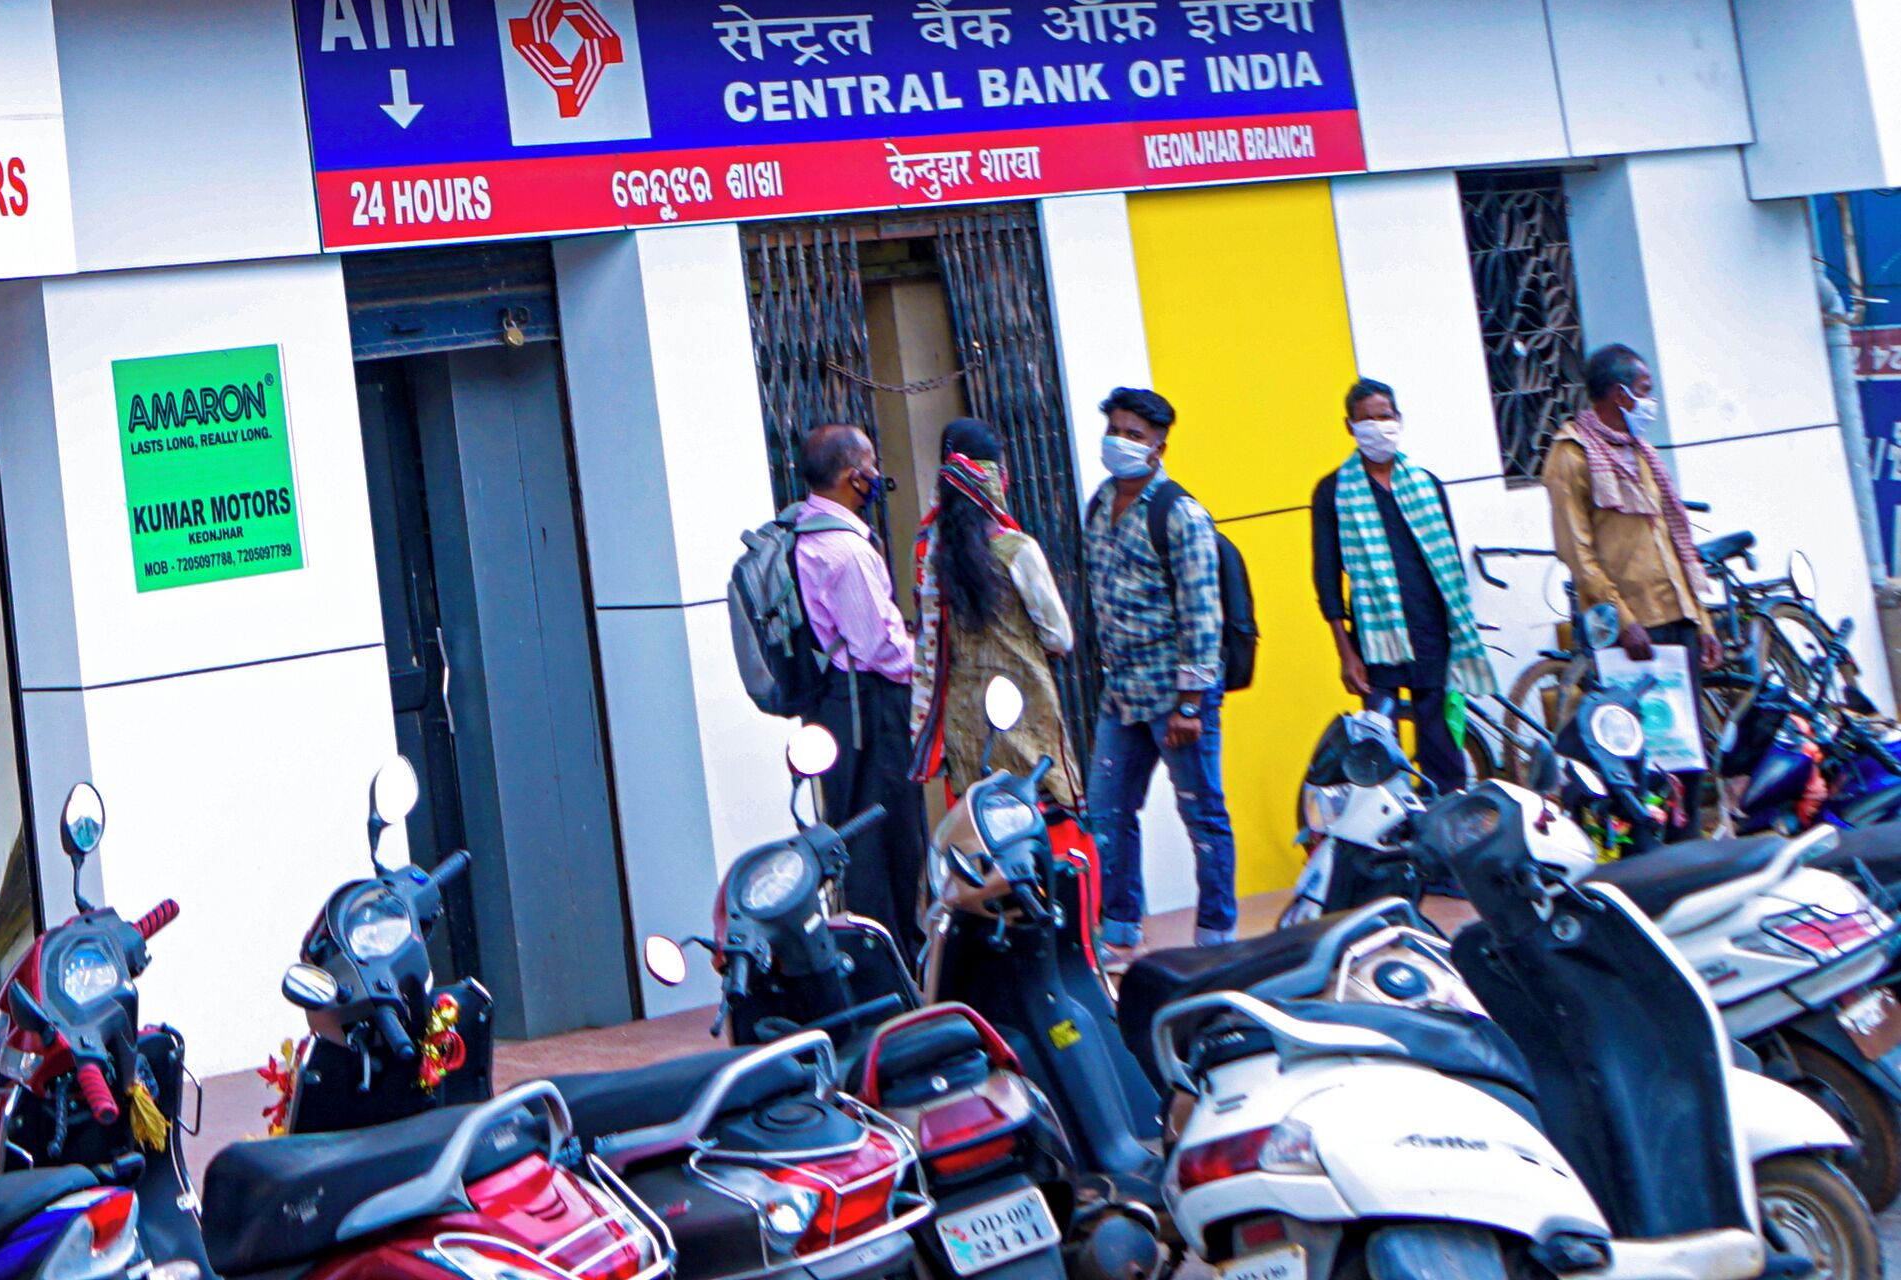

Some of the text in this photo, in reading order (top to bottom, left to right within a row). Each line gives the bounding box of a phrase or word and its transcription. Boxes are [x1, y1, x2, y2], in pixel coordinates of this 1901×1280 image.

[712, 4, 873, 66] सेन्ट्रल
[723, 50, 1323, 123] CENTRAL BANK OF INDIA
[978, 145, 1042, 183] शाखा
[1143, 124, 1316, 169] KEONJHAR BRANCH
[350, 175, 492, 227] 24 HOURS
[725, 160, 784, 200] ଶାଖା
[130, 426, 273, 455] LASTS LONG, REALLY LONG.
[133, 487, 292, 534] KUMAR MOTORS
[187, 526, 244, 545] KEONJHAR
[144, 560, 169, 576] MOB
